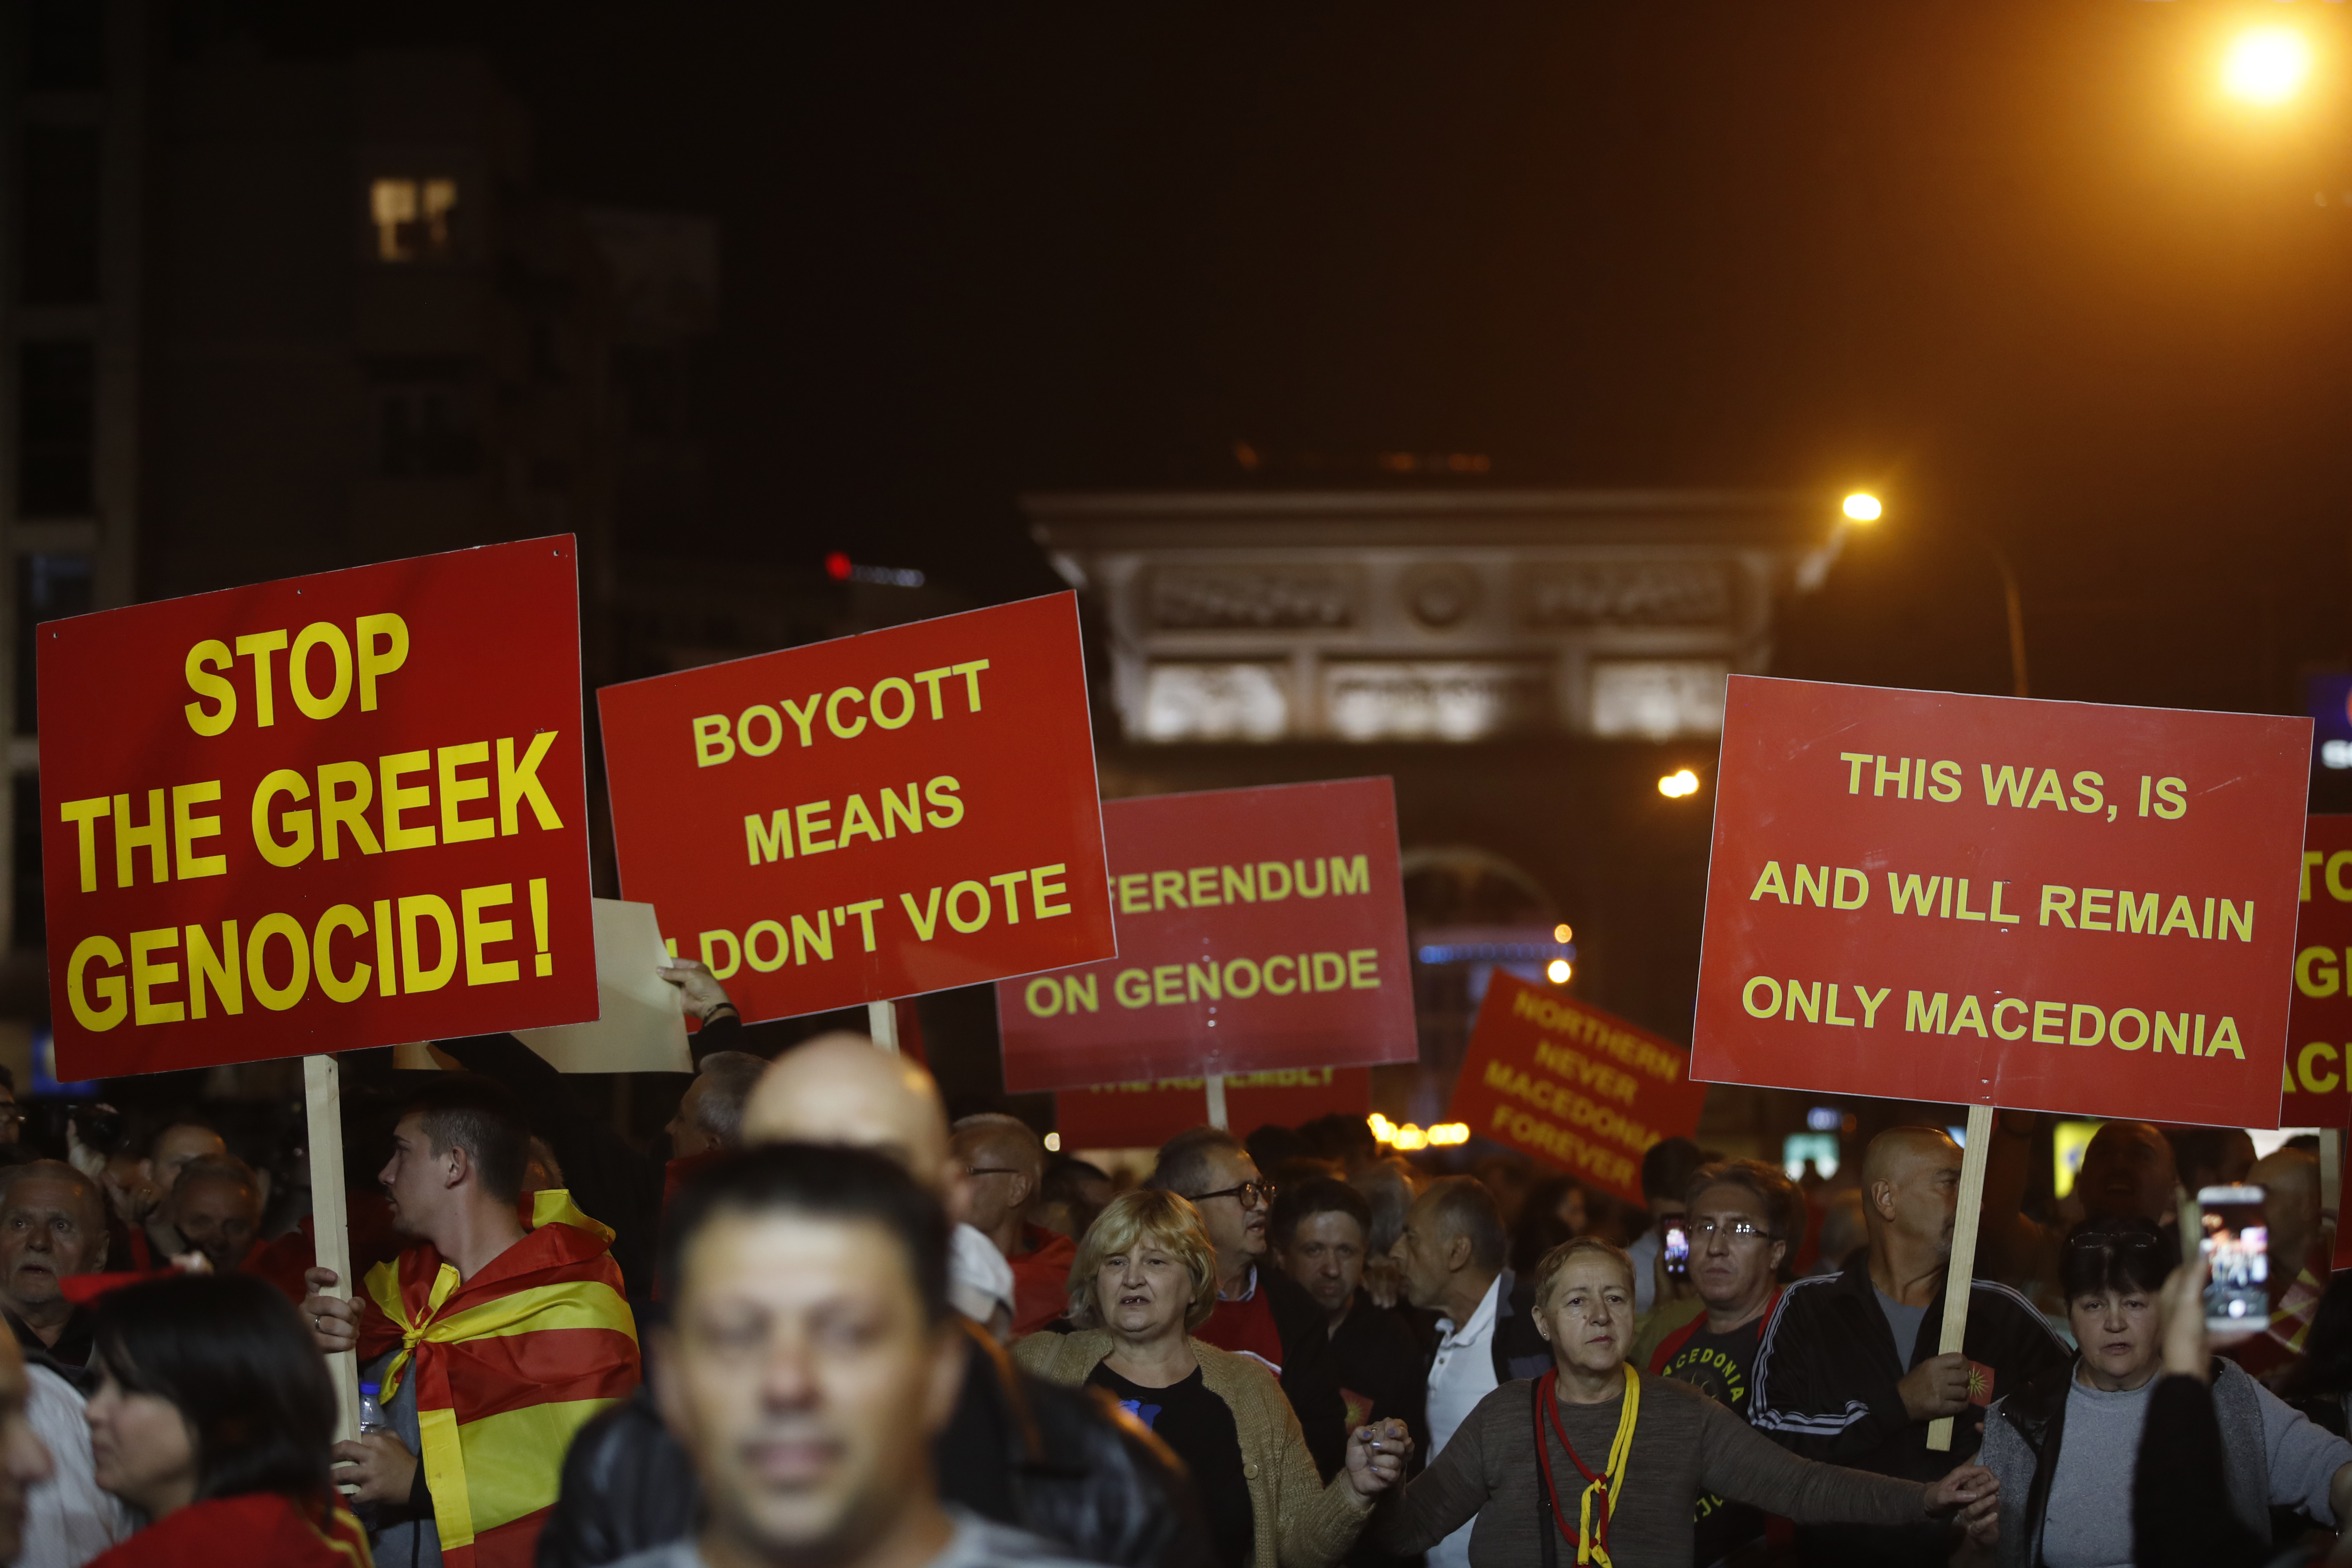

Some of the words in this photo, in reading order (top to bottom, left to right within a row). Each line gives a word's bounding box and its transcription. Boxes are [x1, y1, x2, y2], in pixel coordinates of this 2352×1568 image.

[185, 613, 410, 736] STOP
[692, 658, 990, 768] BOYCOTT
[61, 780, 227, 893] THE
[251, 730, 564, 868] GREEK
[744, 775, 965, 867] MEANS
[1841, 752, 1963, 802] THIS
[1981, 764, 2118, 823] WAS,
[2138, 775, 2188, 820] IS
[698, 898, 885, 981] DON'T
[900, 862, 1072, 941] VOTE
[1109, 854, 1371, 915] ERENDUM
[1750, 861, 1870, 910] AND
[1888, 872, 2021, 924] WILL
[2039, 885, 2255, 943] REMAIN
[67, 878, 553, 1032] GENOCIDE!
[1025, 973, 1099, 1018] ON
[1114, 949, 1381, 1009] GENOCIDE
[1513, 990, 1680, 1082] NORTHERN
[1742, 975, 1891, 1028] ONLY
[1905, 990, 2246, 1060] MACEDONIA
[1534, 1039, 1638, 1106] NEVER
[1491, 1105, 1634, 1188] FOREVER
